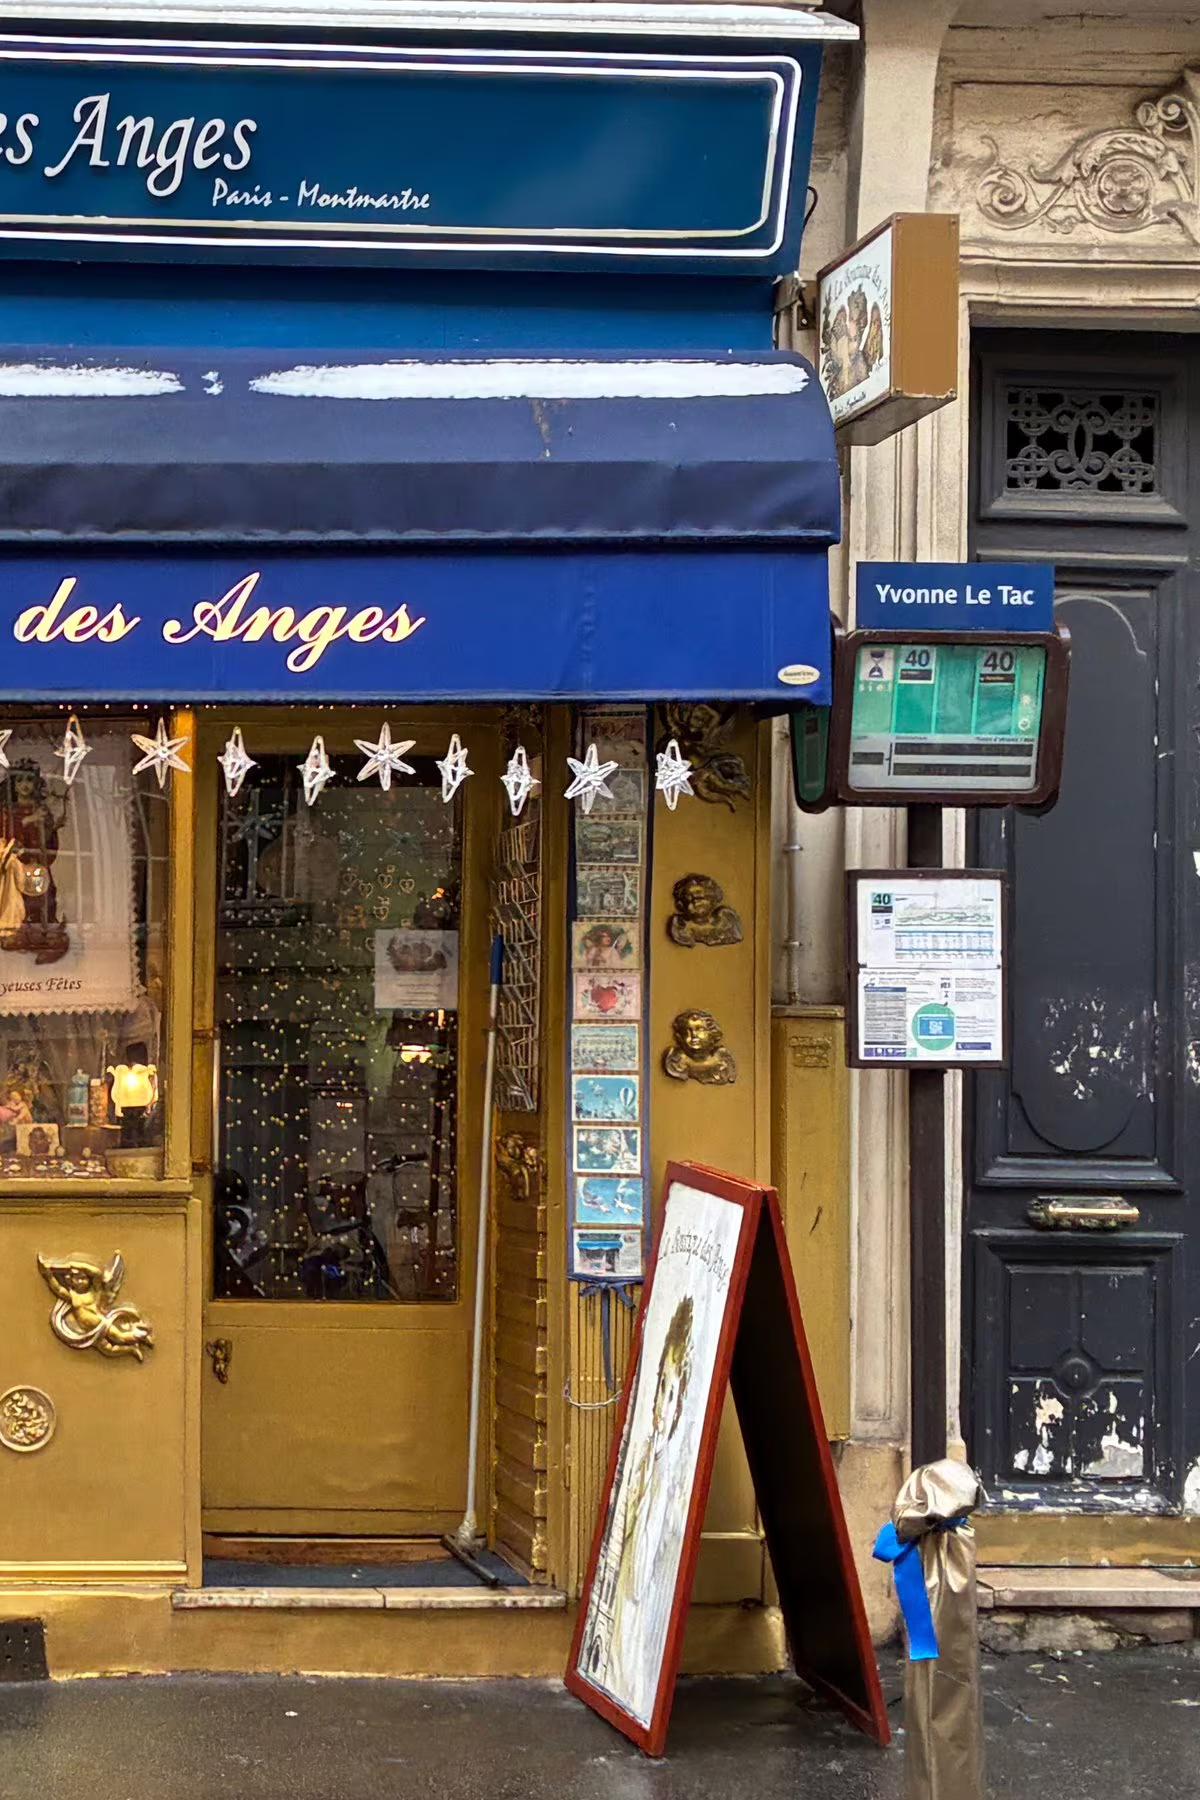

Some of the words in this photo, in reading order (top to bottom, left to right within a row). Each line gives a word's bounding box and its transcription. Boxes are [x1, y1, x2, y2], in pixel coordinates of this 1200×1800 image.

[43, 92, 258, 198] Anges
[212, 177, 273, 207] Paris
[296, 179, 430, 210] Montmartre
[875, 584, 958, 604] Yvonne
[965, 585, 992, 605] Le
[997, 585, 1035, 605] Tac
[12, 576, 142, 643] des
[162, 571, 427, 673] Anges
[905, 650, 930, 667] 40
[983, 651, 1014, 672] 40
[872, 893, 891, 905] 40
[45, 977, 83, 991] Fêtes
